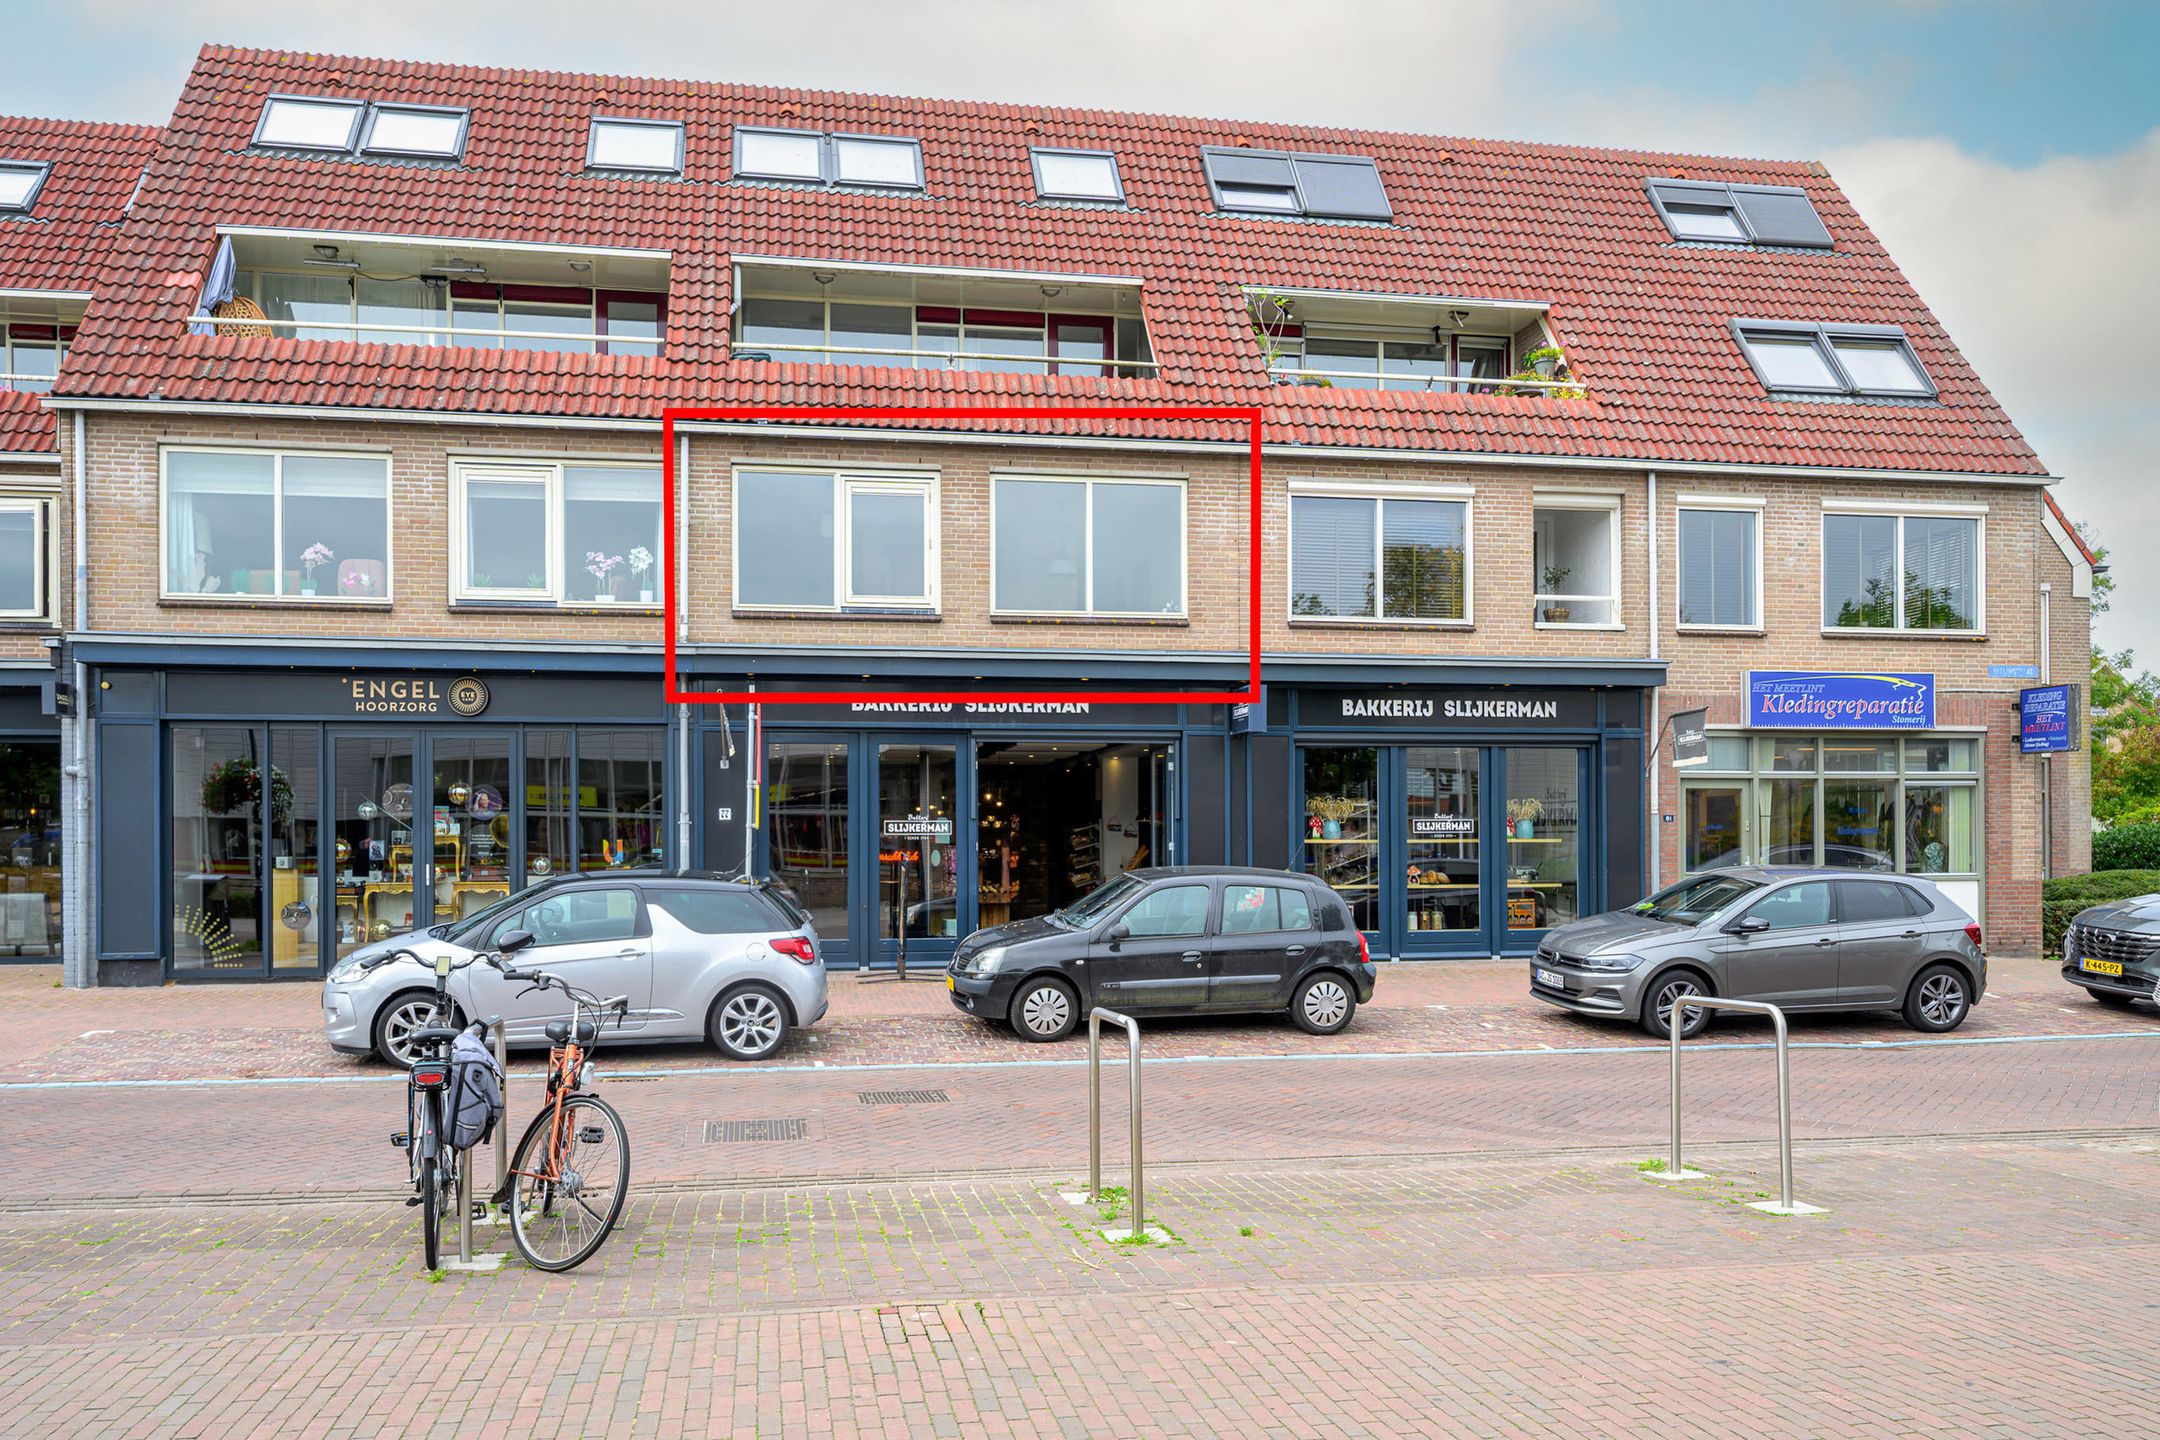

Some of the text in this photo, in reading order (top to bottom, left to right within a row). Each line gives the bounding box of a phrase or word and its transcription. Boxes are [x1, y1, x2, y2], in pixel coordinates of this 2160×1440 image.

[352, 680, 440, 699] ENGEL
[1752, 683, 1825, 694] HET MEETLINT
[2028, 691, 2062, 703] KLEDING
[355, 702, 437, 712] HOORZORG
[1342, 699, 1557, 718] BAKKERIJ SLIJKERMAN
[1761, 694, 1925, 720] Kledingreparatie
[2024, 701, 2066, 713] REPARATIE
[1892, 715, 1926, 725] Stomerij
[2036, 714, 2053, 724] HET
[888, 823, 948, 833] SLIJKERMAN
[1416, 822, 1471, 831] SLIJKERMAN
